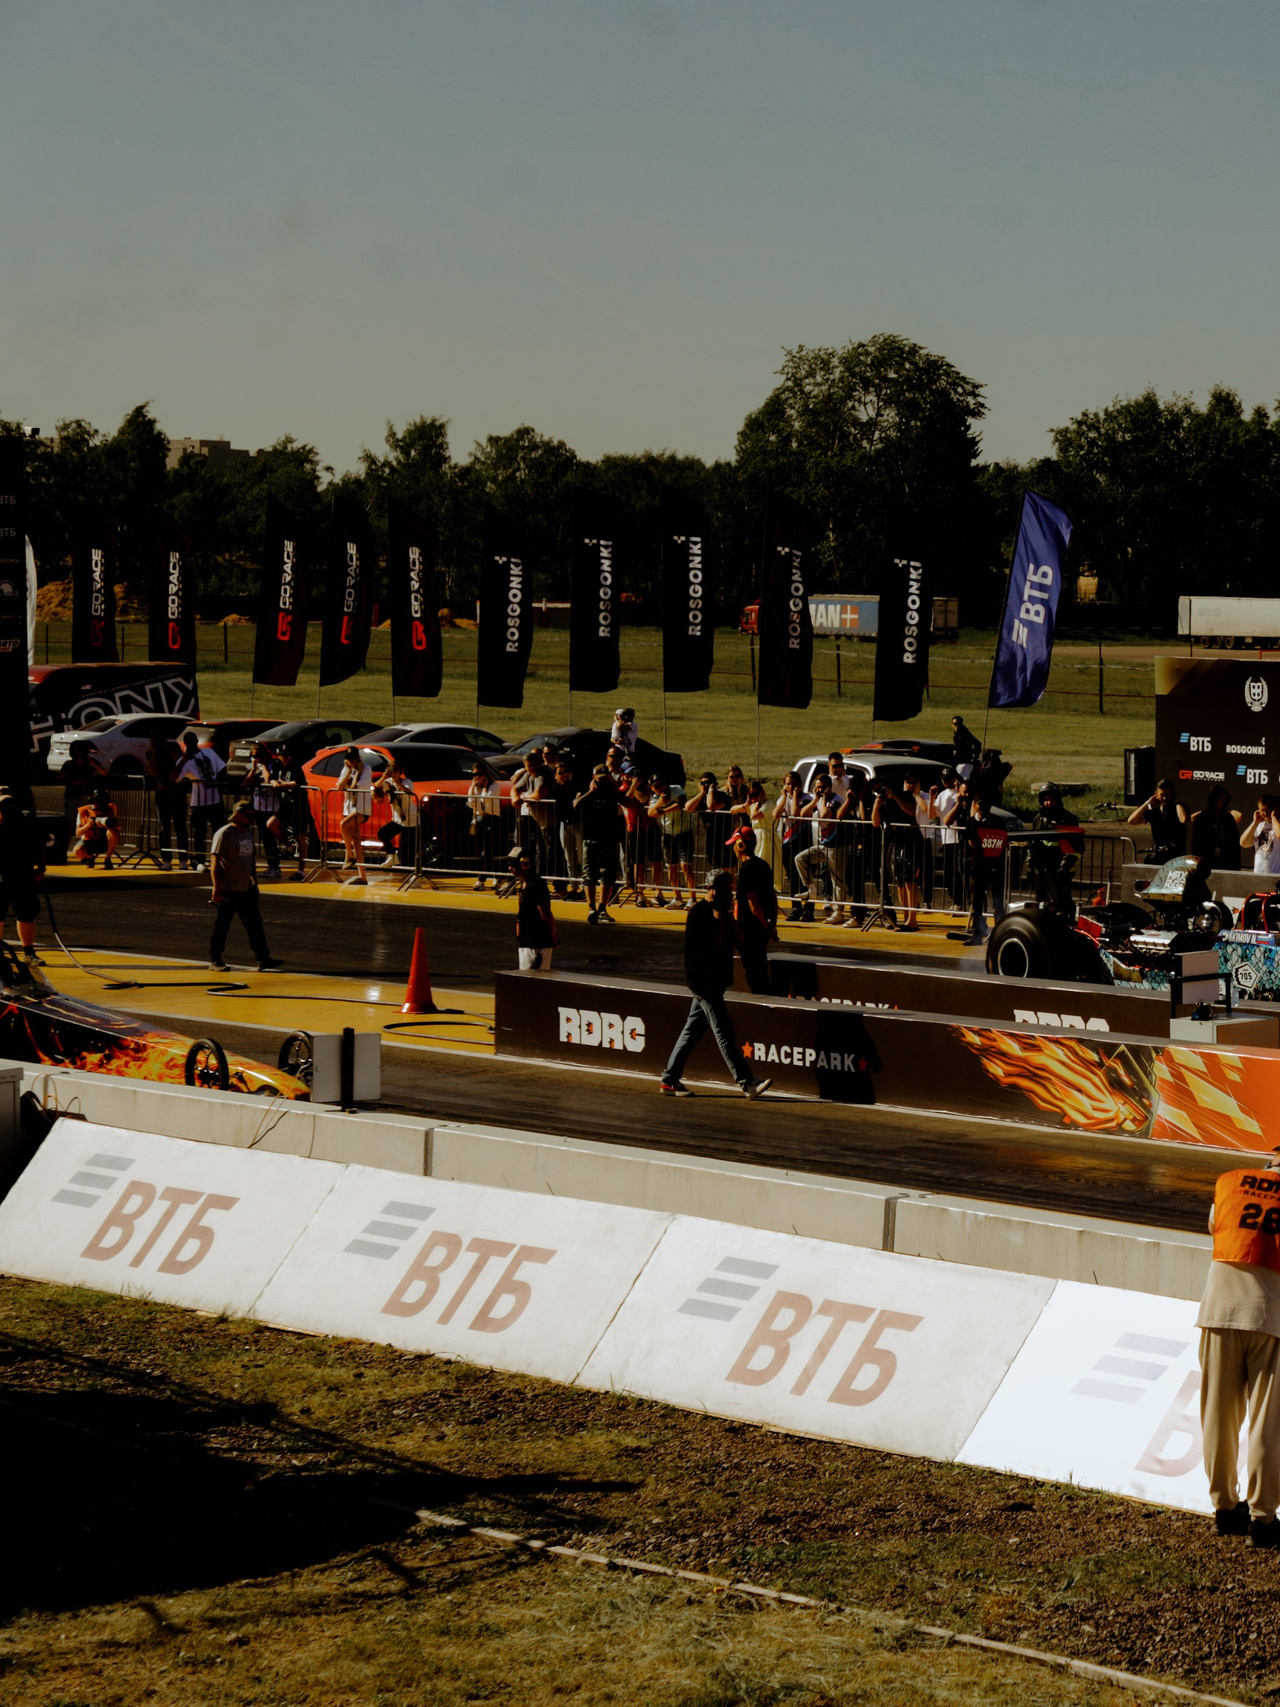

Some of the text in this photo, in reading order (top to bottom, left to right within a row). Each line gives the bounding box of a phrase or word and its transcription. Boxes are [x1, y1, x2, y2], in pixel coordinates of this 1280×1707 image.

[505, 558, 523, 652] ROSGONKI
[598, 540, 612, 638] ROSGONKI
[688, 536, 703, 637] ROSGONKI
[788, 550, 804, 650] ROSGONKI
[903, 561, 922, 664] ROSGONKI
[1020, 563, 1054, 625] ВТБ
[1190, 736, 1212, 752] ВТБ
[1226, 745, 1266, 755] ROSGONKI
[1246, 769, 1268, 784] ВТБ
[558, 1006, 646, 1054] RDRC
[753, 1043, 856, 1072] RACEPARK
[80, 1180, 240, 1275] ВТБ
[380, 1230, 558, 1335] ВТБ
[724, 1290, 924, 1407] ВТБ
